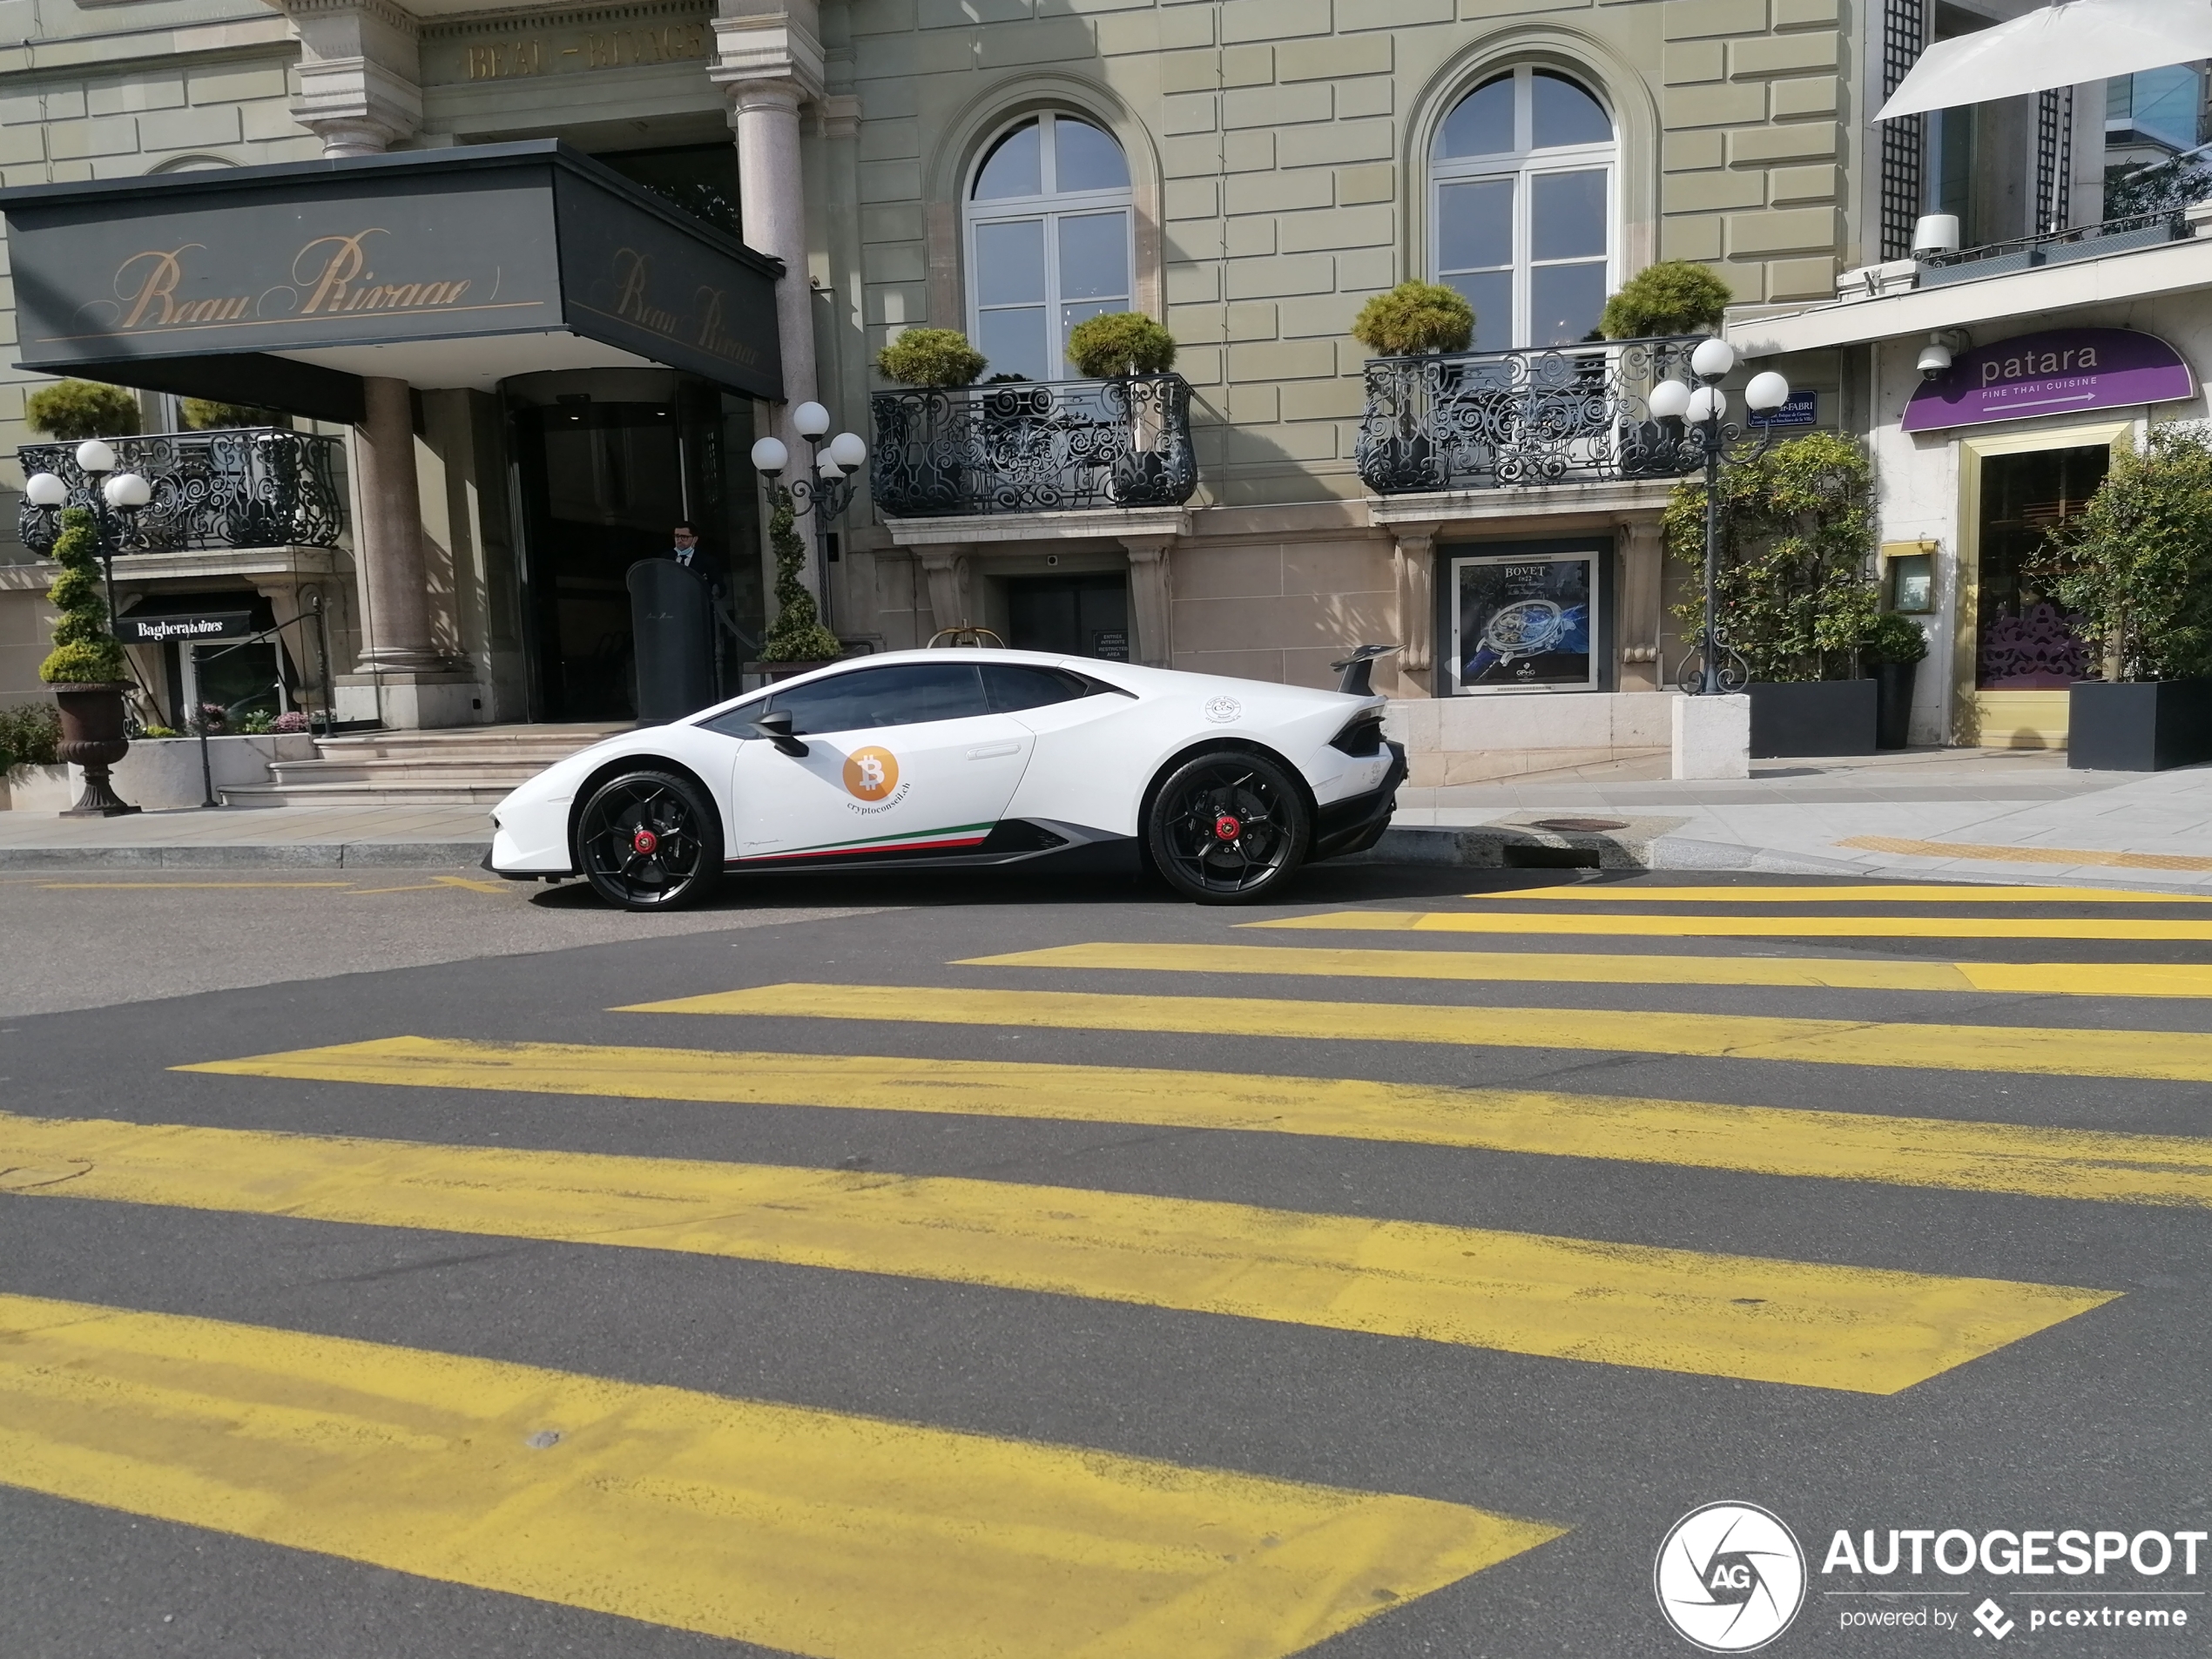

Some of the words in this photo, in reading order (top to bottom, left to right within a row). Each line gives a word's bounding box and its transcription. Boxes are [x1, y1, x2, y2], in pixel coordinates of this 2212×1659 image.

[114, 243, 251, 329] Beau
[1981, 347, 2097, 388] patara
[1982, 389, 2007, 399] FINE
[2013, 384, 2040, 395] THAI
[2047, 376, 2097, 391] CUISINE
[1505, 566, 1546, 578] BOVET
[846, 782, 911, 815] cryptoconseil.ch
